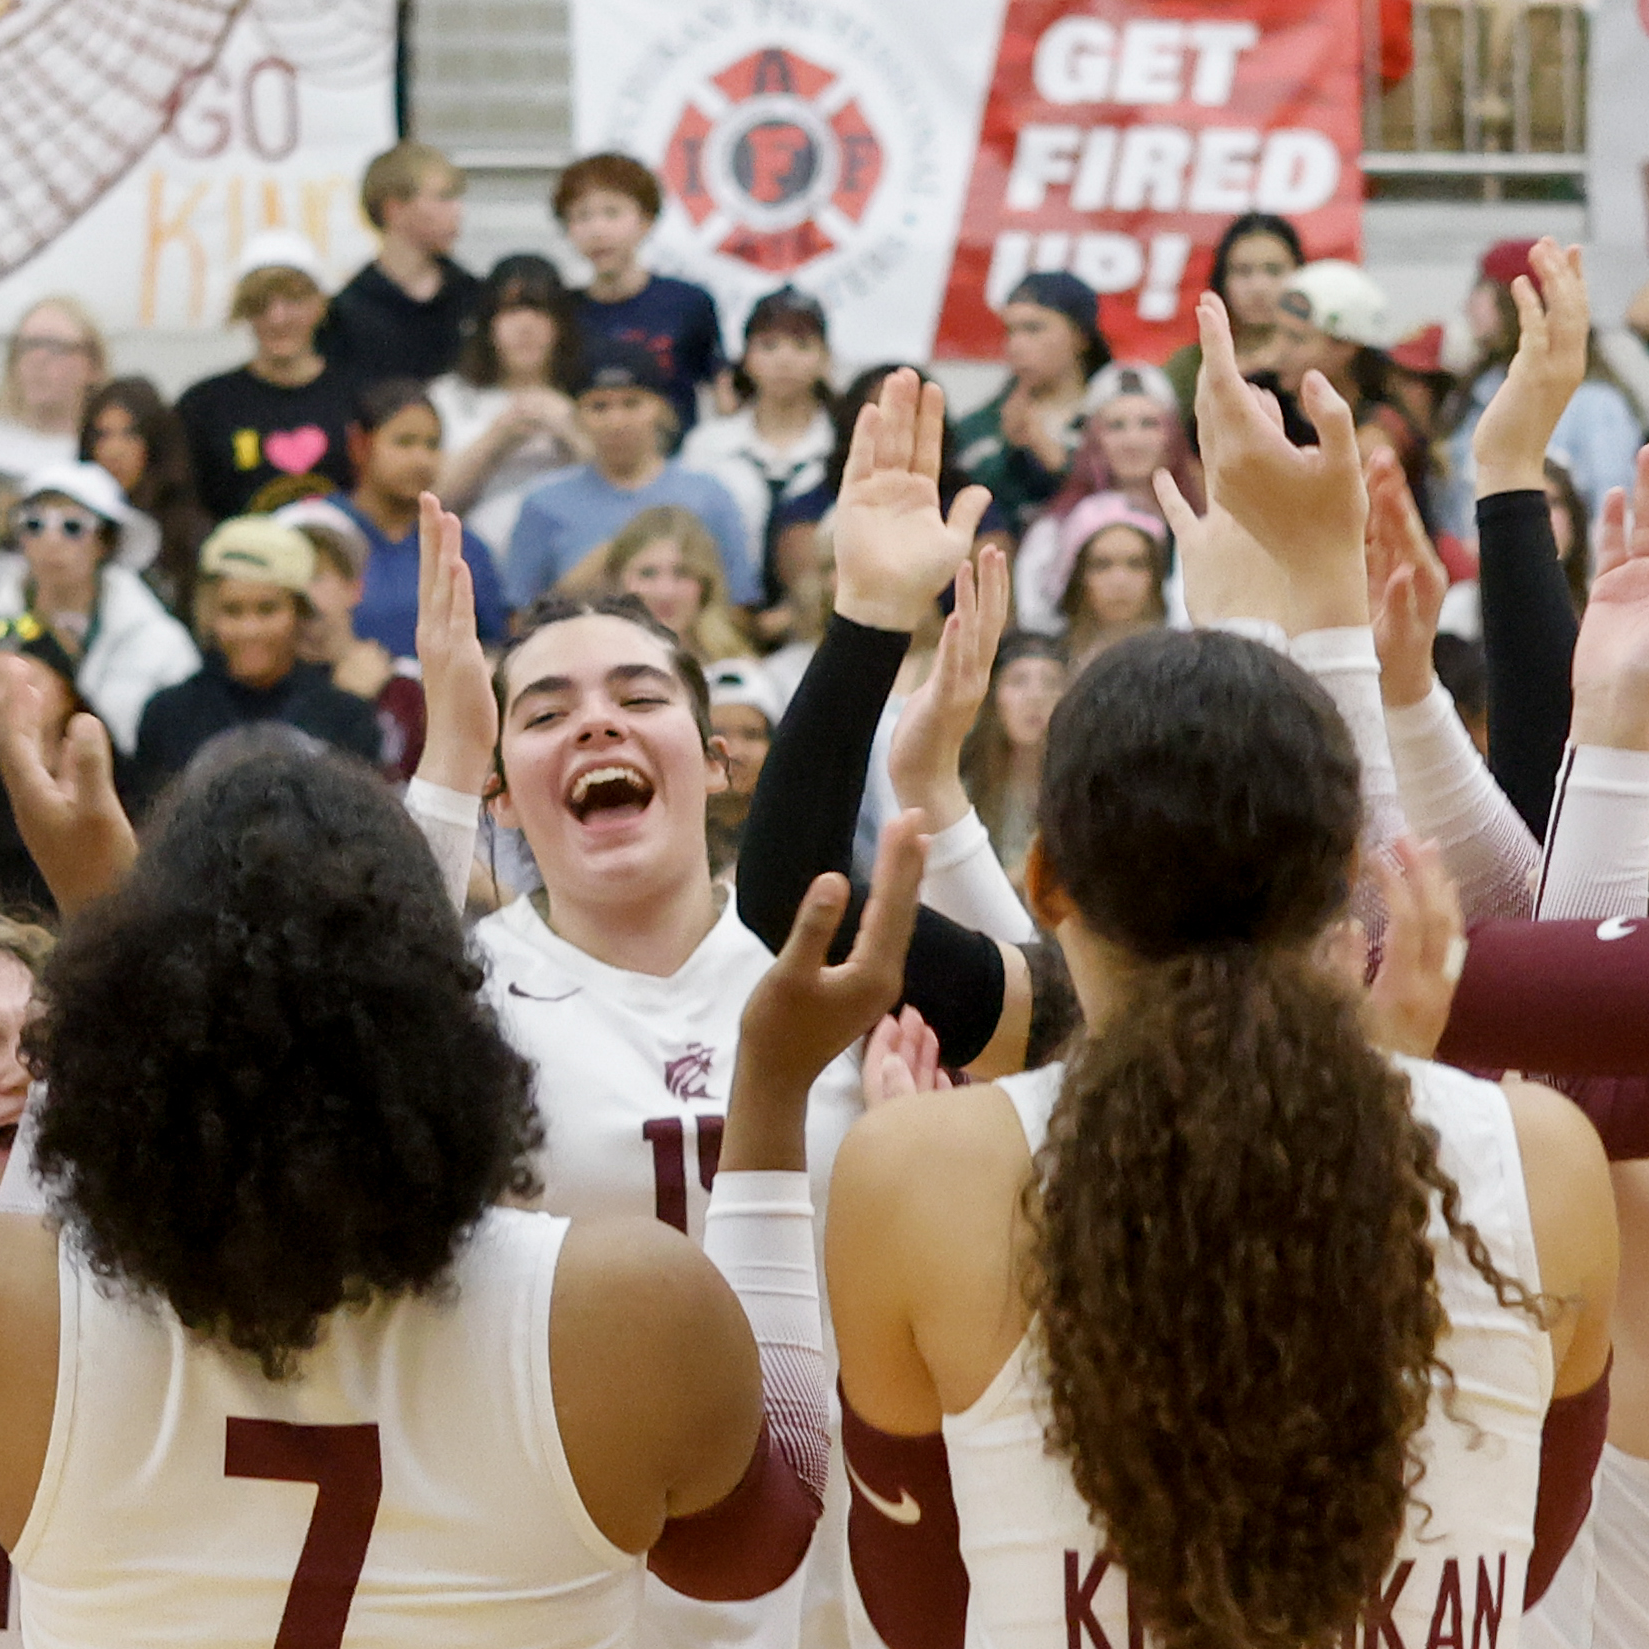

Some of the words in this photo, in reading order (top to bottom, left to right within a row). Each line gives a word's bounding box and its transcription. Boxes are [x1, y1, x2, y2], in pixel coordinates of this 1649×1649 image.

[1032, 16, 1259, 106] GET
[163, 55, 302, 163] GO
[1005, 123, 1341, 213] FIRED
